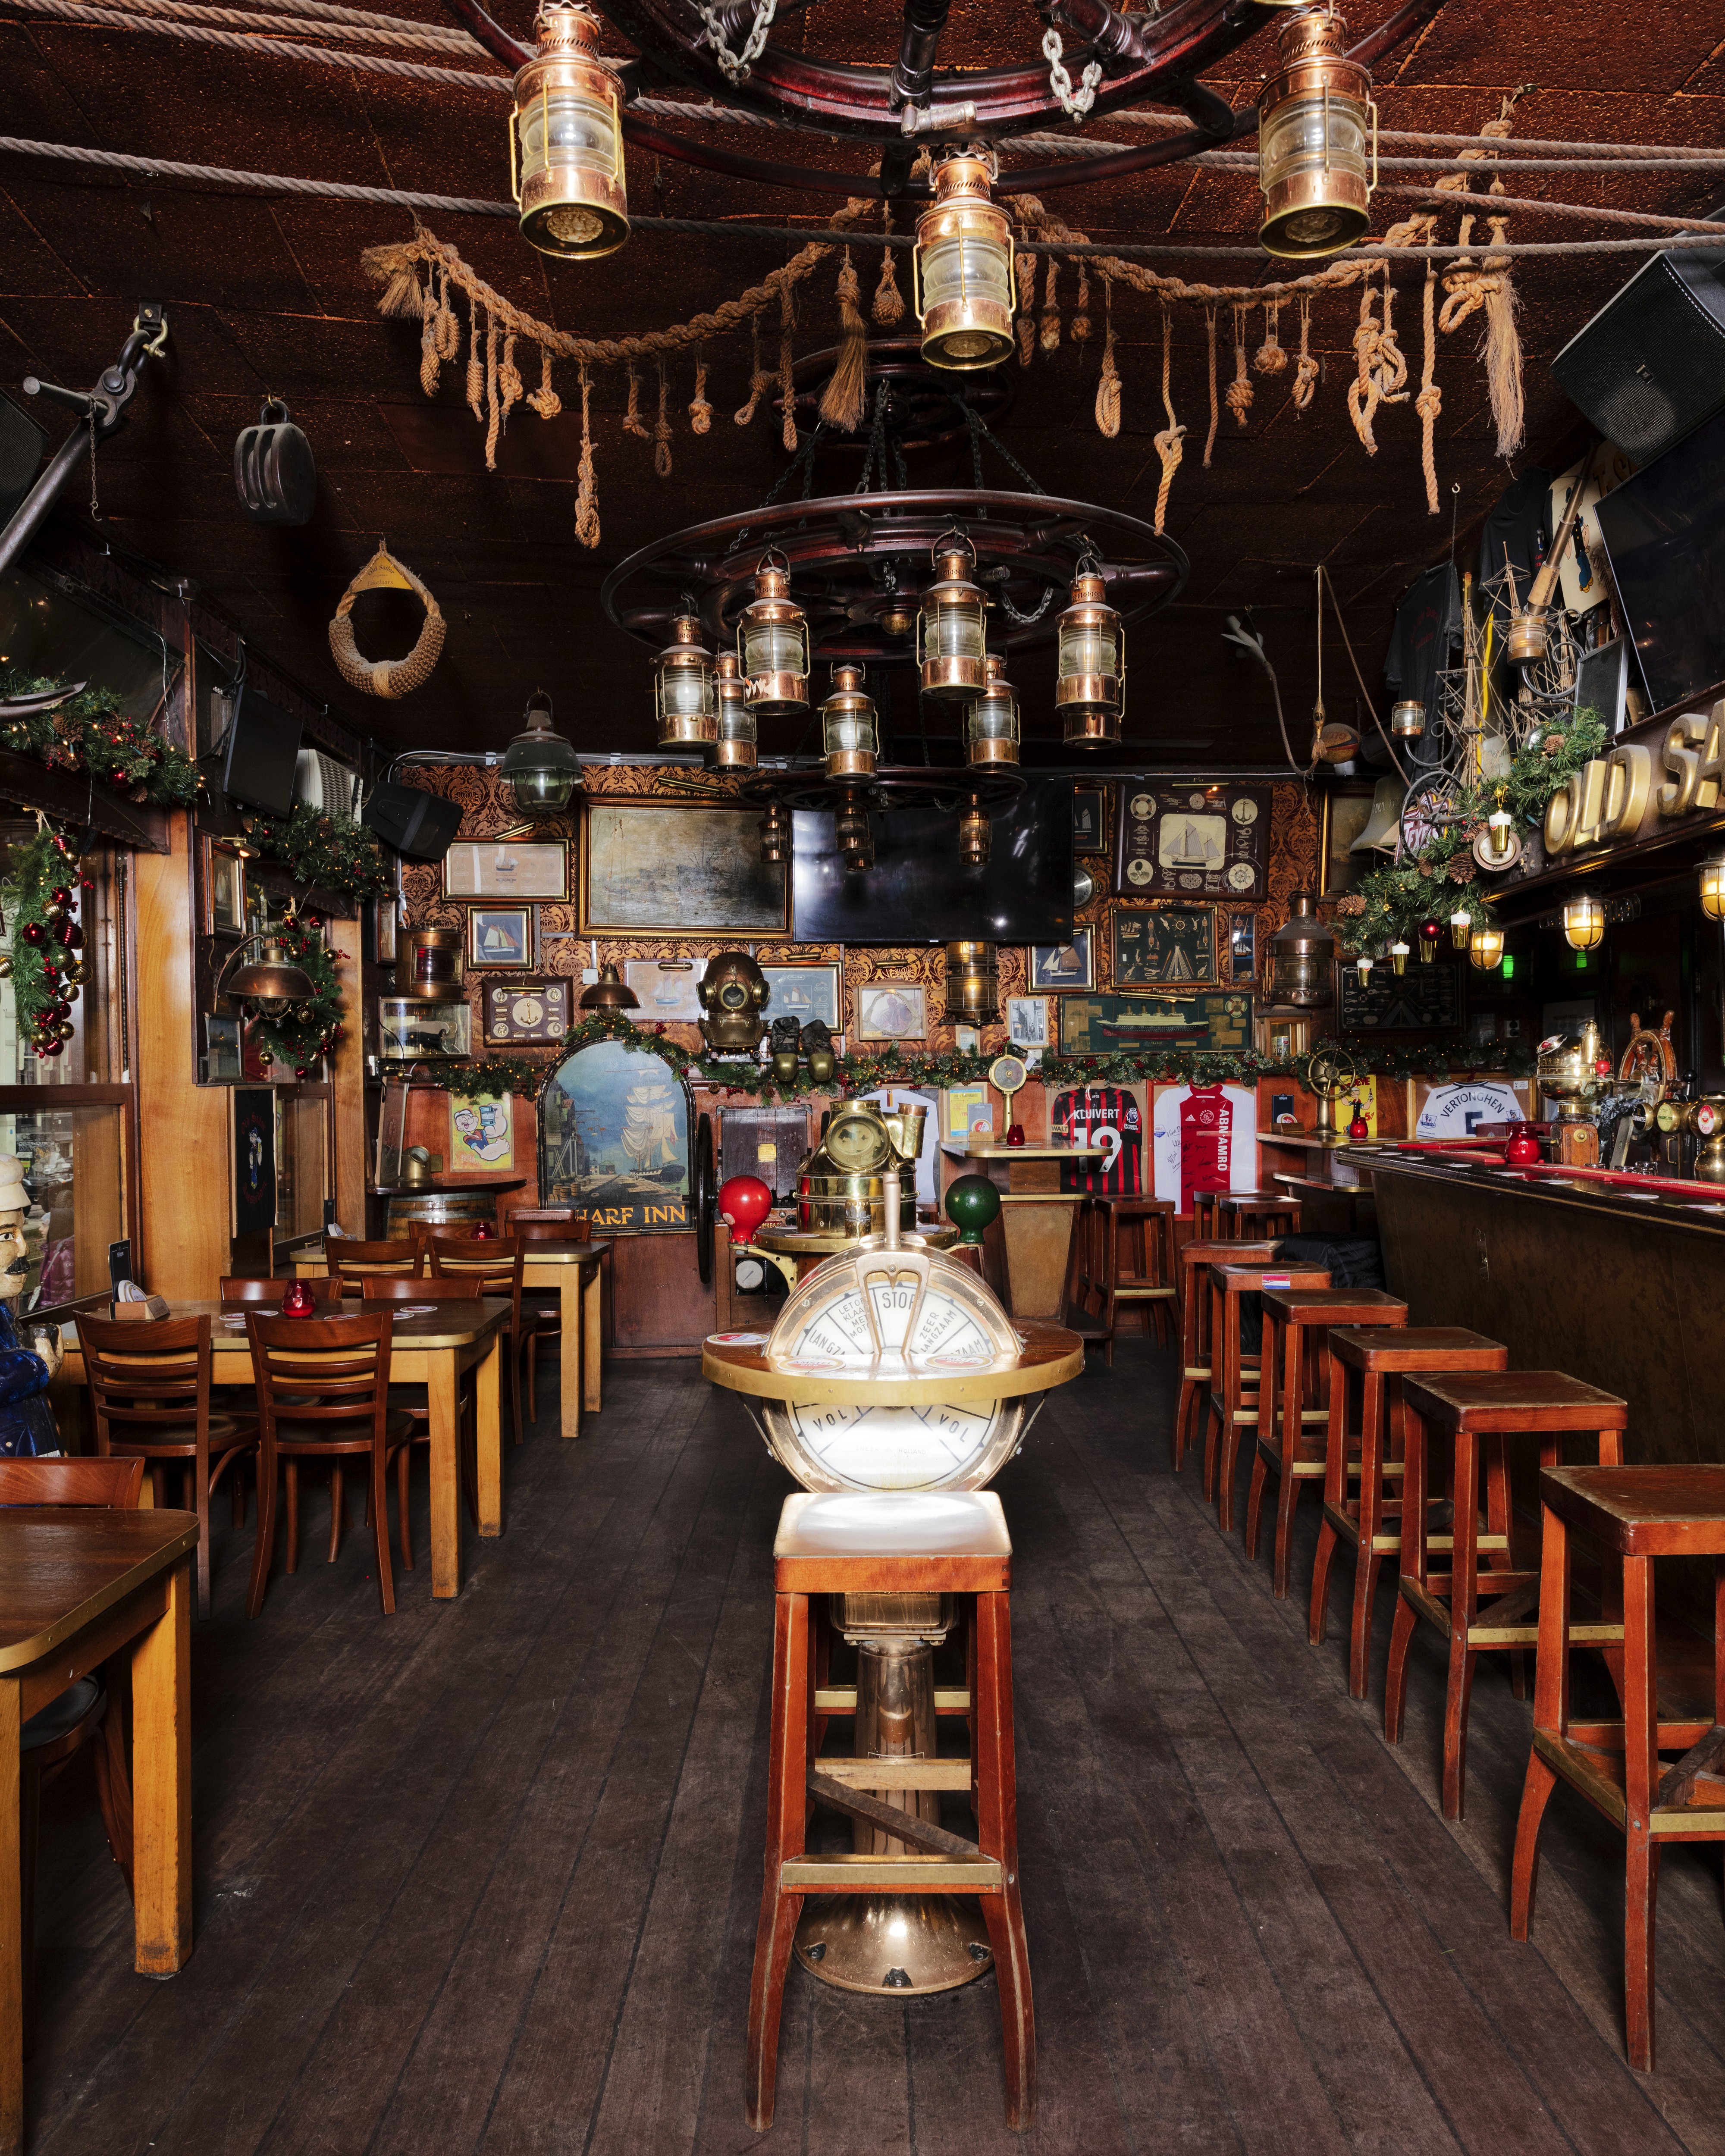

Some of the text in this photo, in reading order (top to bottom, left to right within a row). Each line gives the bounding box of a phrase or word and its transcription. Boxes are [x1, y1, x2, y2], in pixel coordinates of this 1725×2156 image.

[1544, 744, 1651, 855] OLD
[1073, 1109, 1120, 1119] KLUIVERT
[1440, 1092, 1505, 1118] VERTONGHEN
[1074, 1126, 1122, 1173] 19
[643, 1205, 686, 1223] INN
[839, 1302, 853, 1315] LET
[919, 1312, 939, 1338] ZEER
[921, 1309, 957, 1352] LANGZAAM
[812, 1409, 847, 1432] VOL
[940, 1413, 970, 1442] VOL
